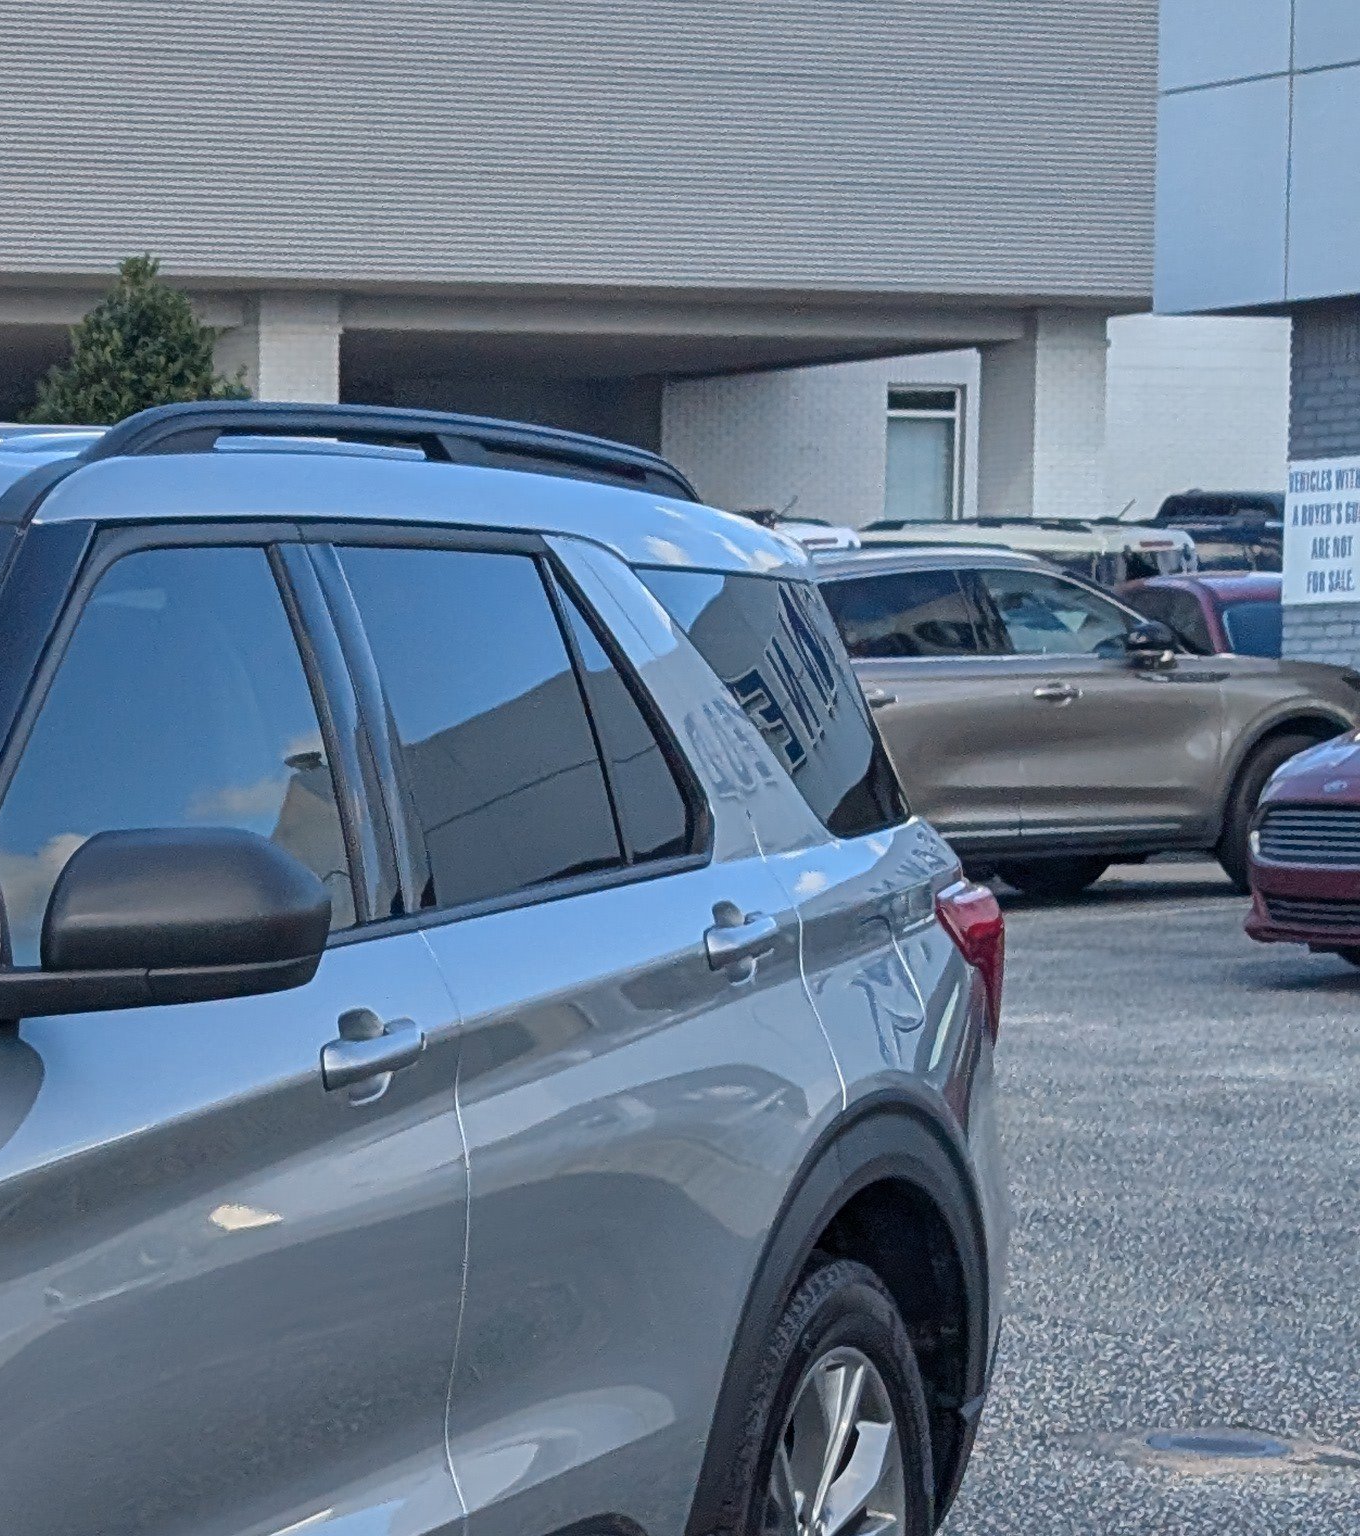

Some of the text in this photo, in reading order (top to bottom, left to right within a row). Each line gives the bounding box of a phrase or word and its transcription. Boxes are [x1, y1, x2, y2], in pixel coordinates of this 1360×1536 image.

[1311, 534, 1354, 559] ARE NOT
[1307, 570, 1326, 593] FOR
